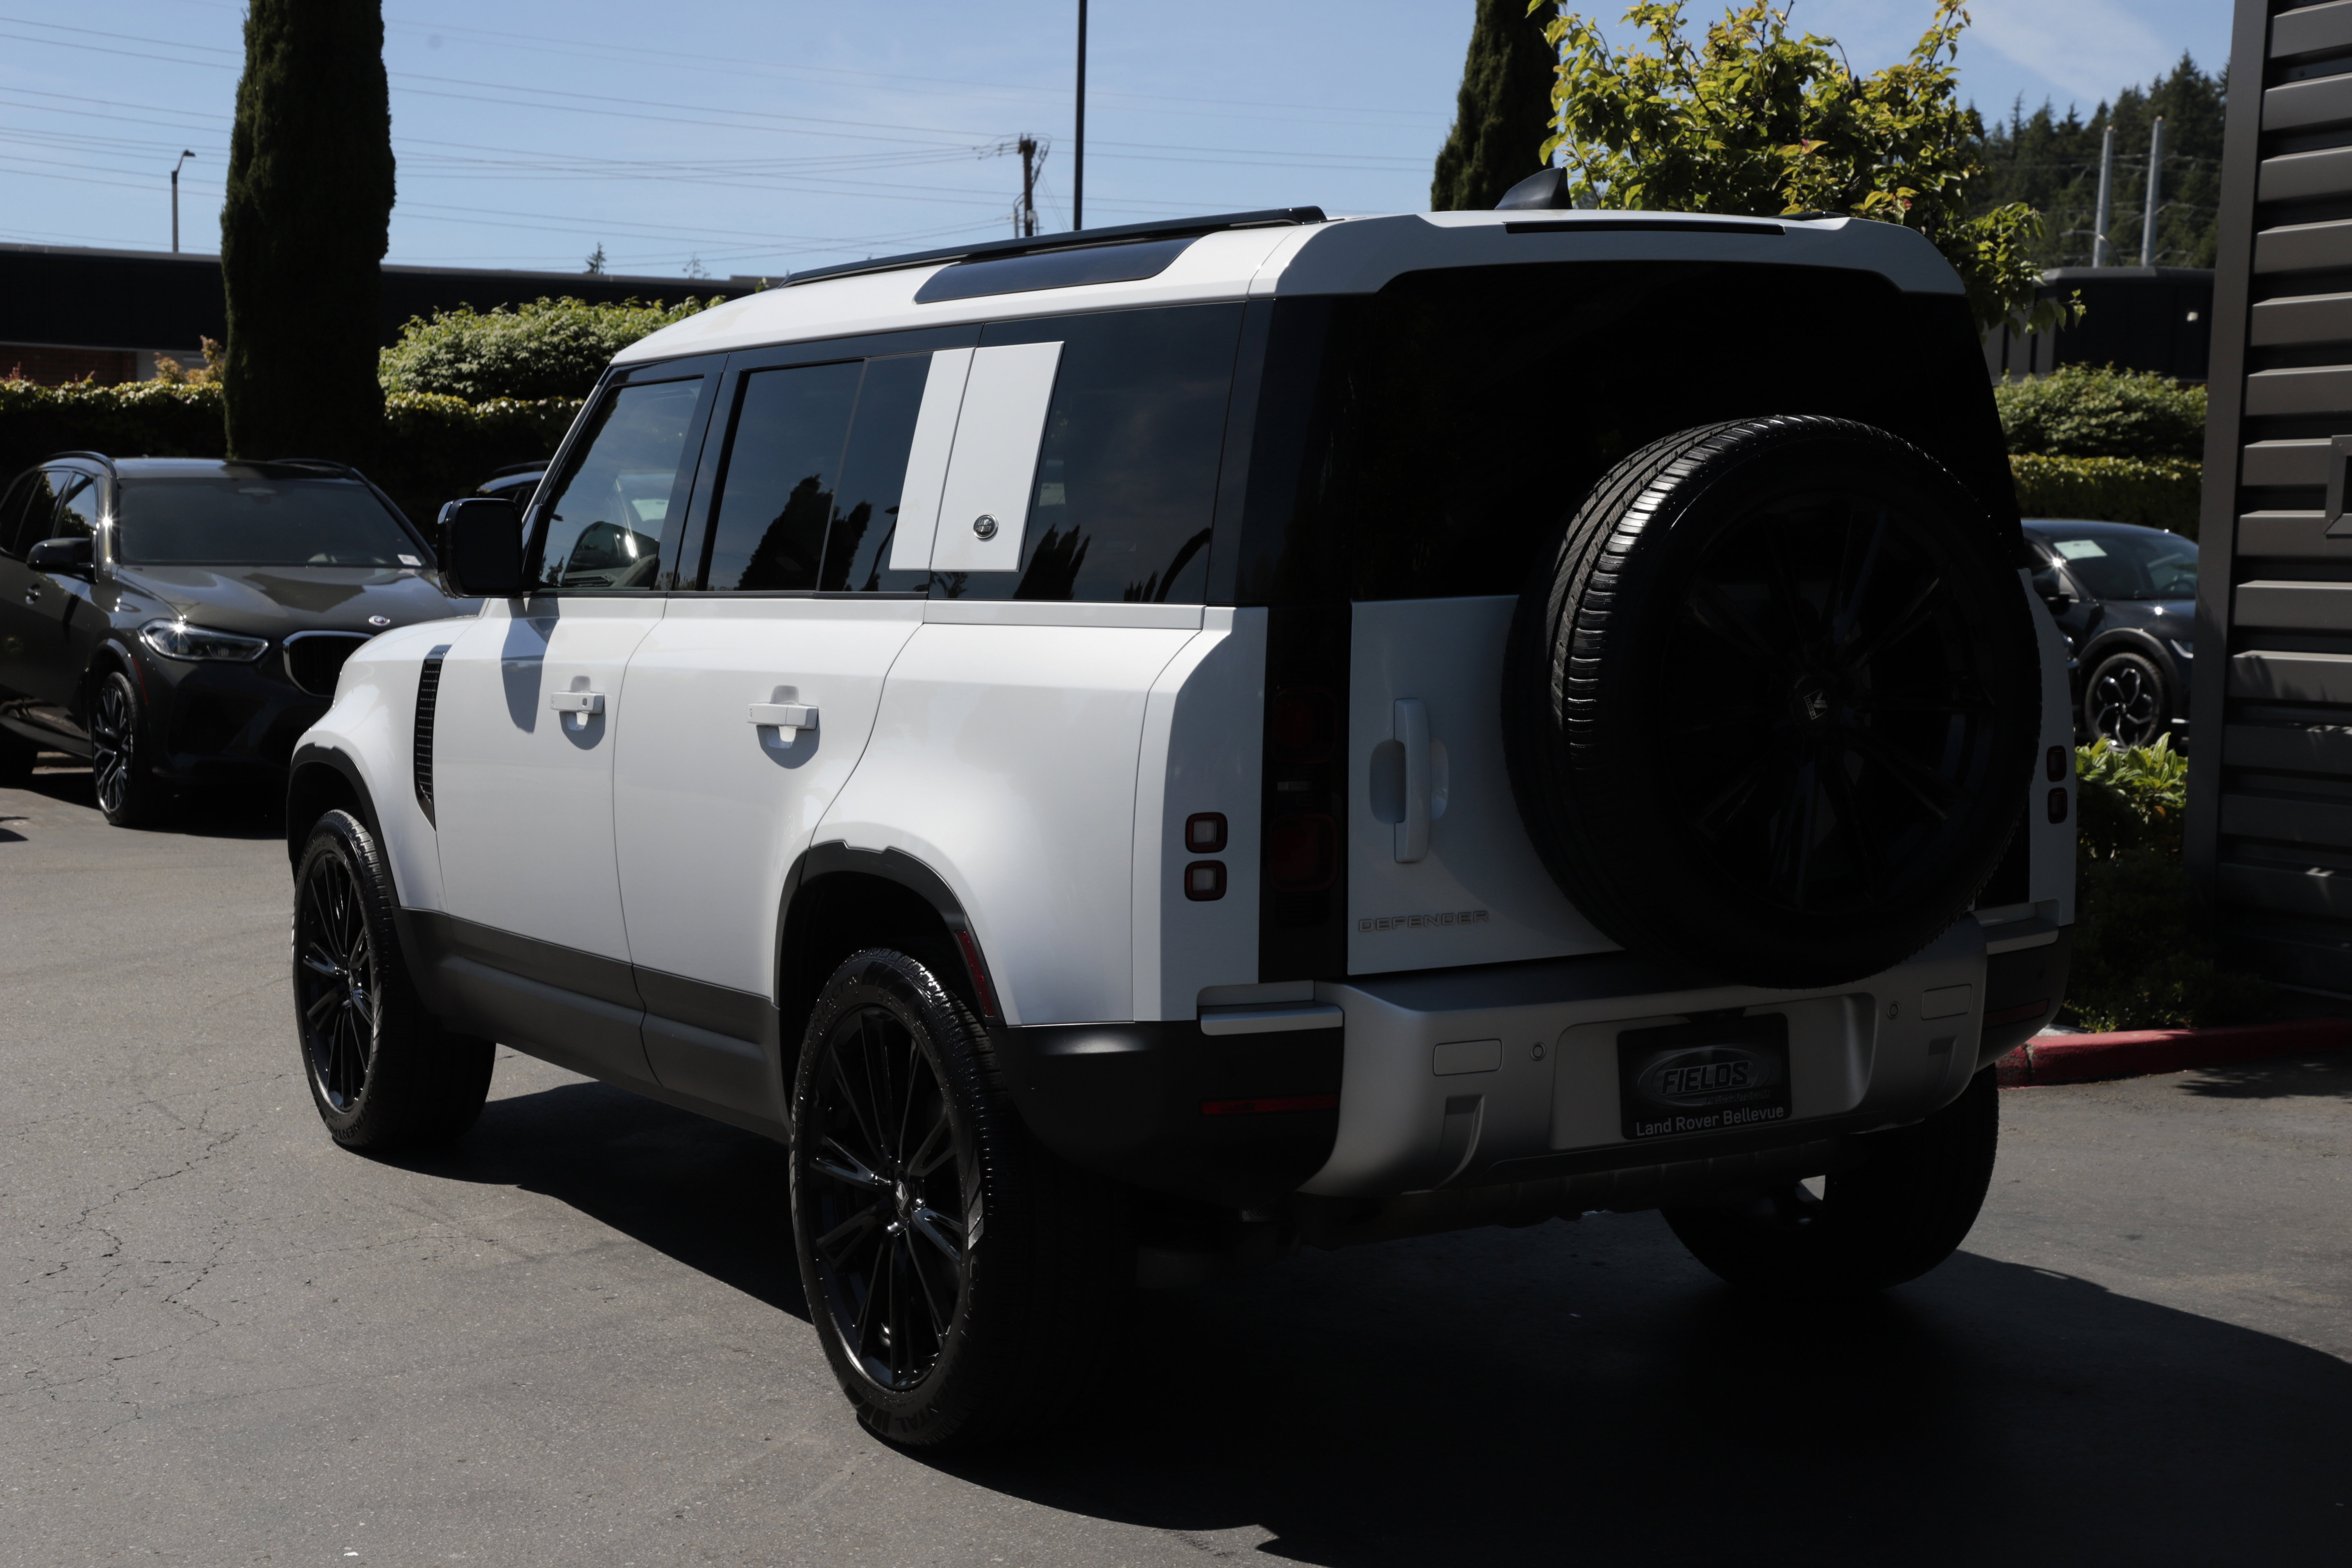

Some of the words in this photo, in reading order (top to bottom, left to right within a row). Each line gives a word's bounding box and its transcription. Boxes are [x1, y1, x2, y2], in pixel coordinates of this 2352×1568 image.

[1359, 910, 1489, 931] DEFENDER
[1661, 1061, 1749, 1095] FIELDS
[1636, 1117, 1672, 1136] Land
[1676, 1115, 1719, 1131] Rover
[1723, 1106, 1784, 1125] Bellevue
